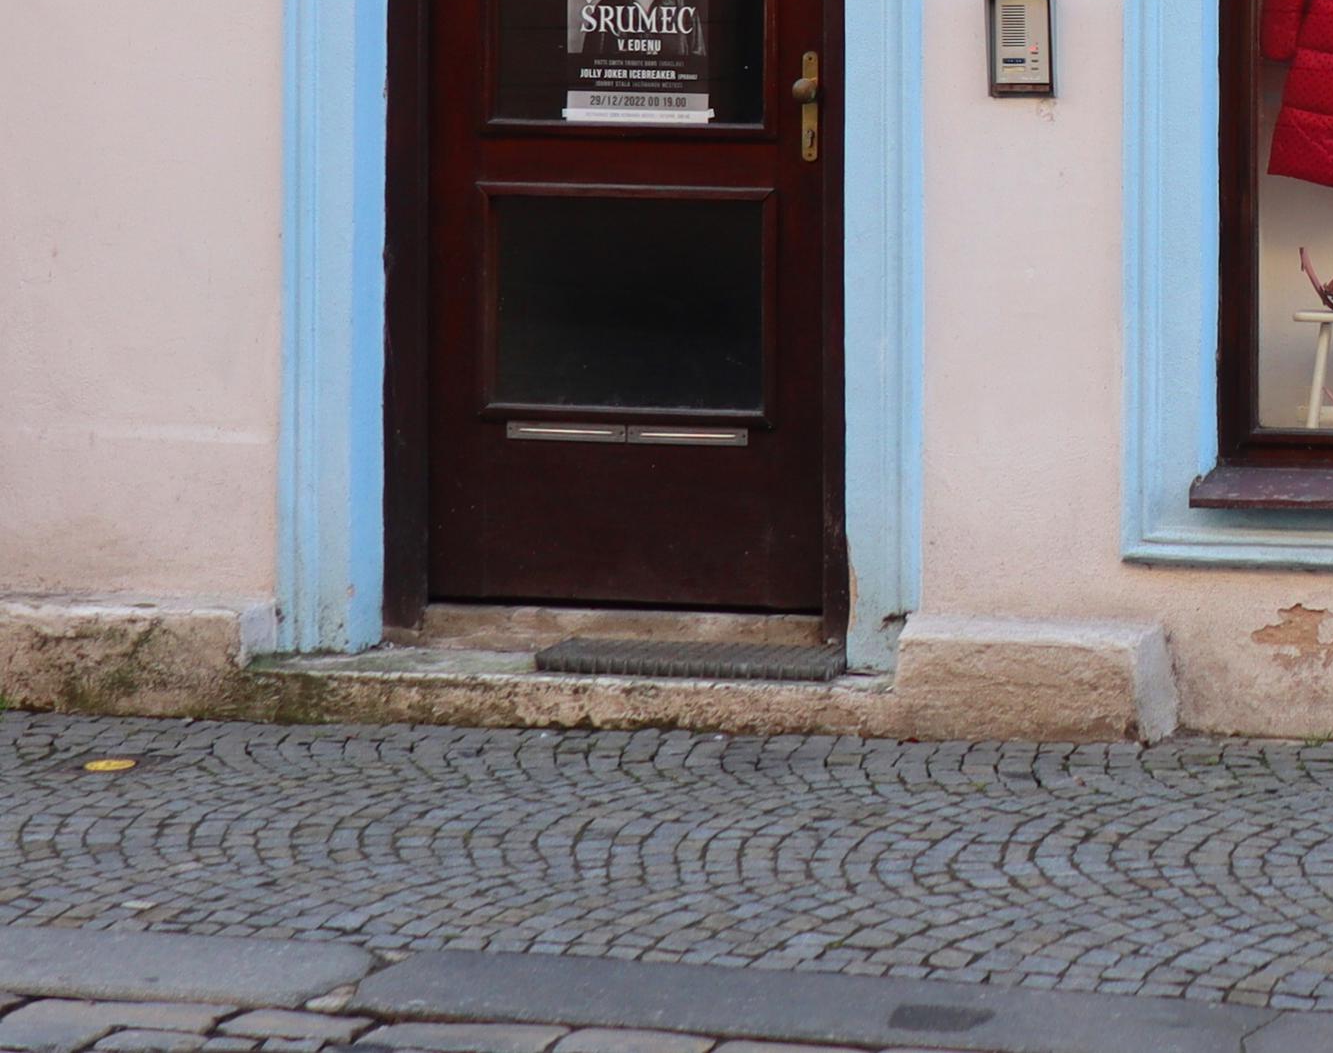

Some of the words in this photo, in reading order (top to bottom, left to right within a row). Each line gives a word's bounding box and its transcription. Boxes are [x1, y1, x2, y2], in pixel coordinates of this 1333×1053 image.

[580, 68, 602, 78] JOLLY
[604, 69, 628, 79] JOKER
[629, 70, 677, 80] ICEBREAKER
